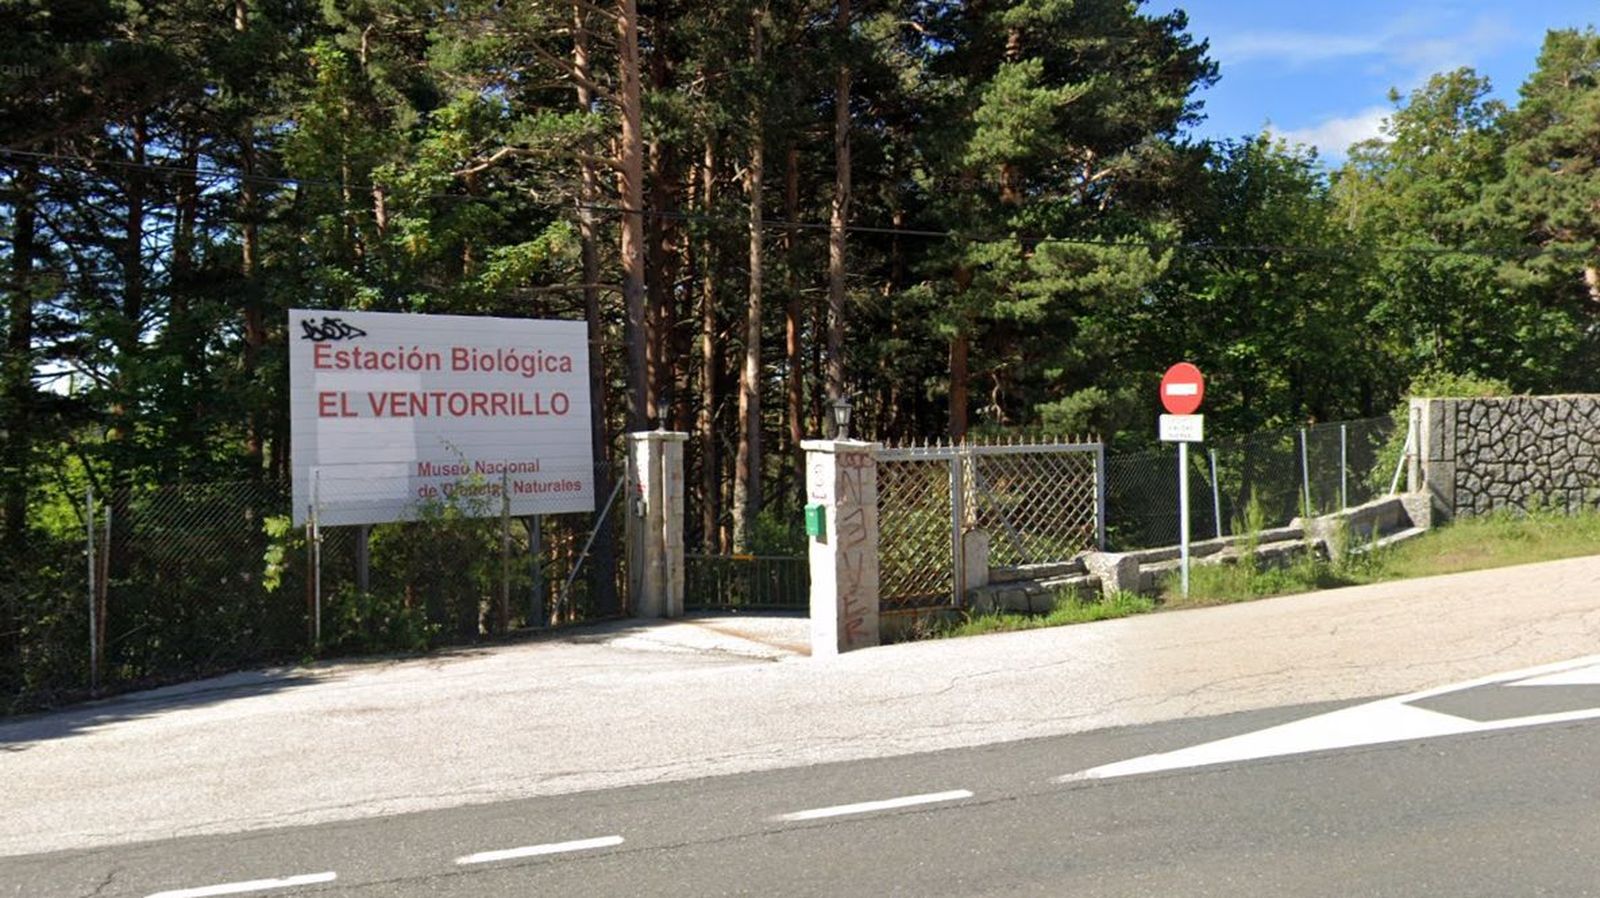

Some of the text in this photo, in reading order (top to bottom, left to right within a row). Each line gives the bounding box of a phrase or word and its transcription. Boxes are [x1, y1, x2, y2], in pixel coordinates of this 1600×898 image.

[313, 343, 572, 378] Estación Biológica
[318, 391, 569, 418] EL VENTORRILLO
[417, 458, 540, 477] Museo Nacional
[417, 484, 437, 498] de
[513, 479, 582, 494] Naturales
